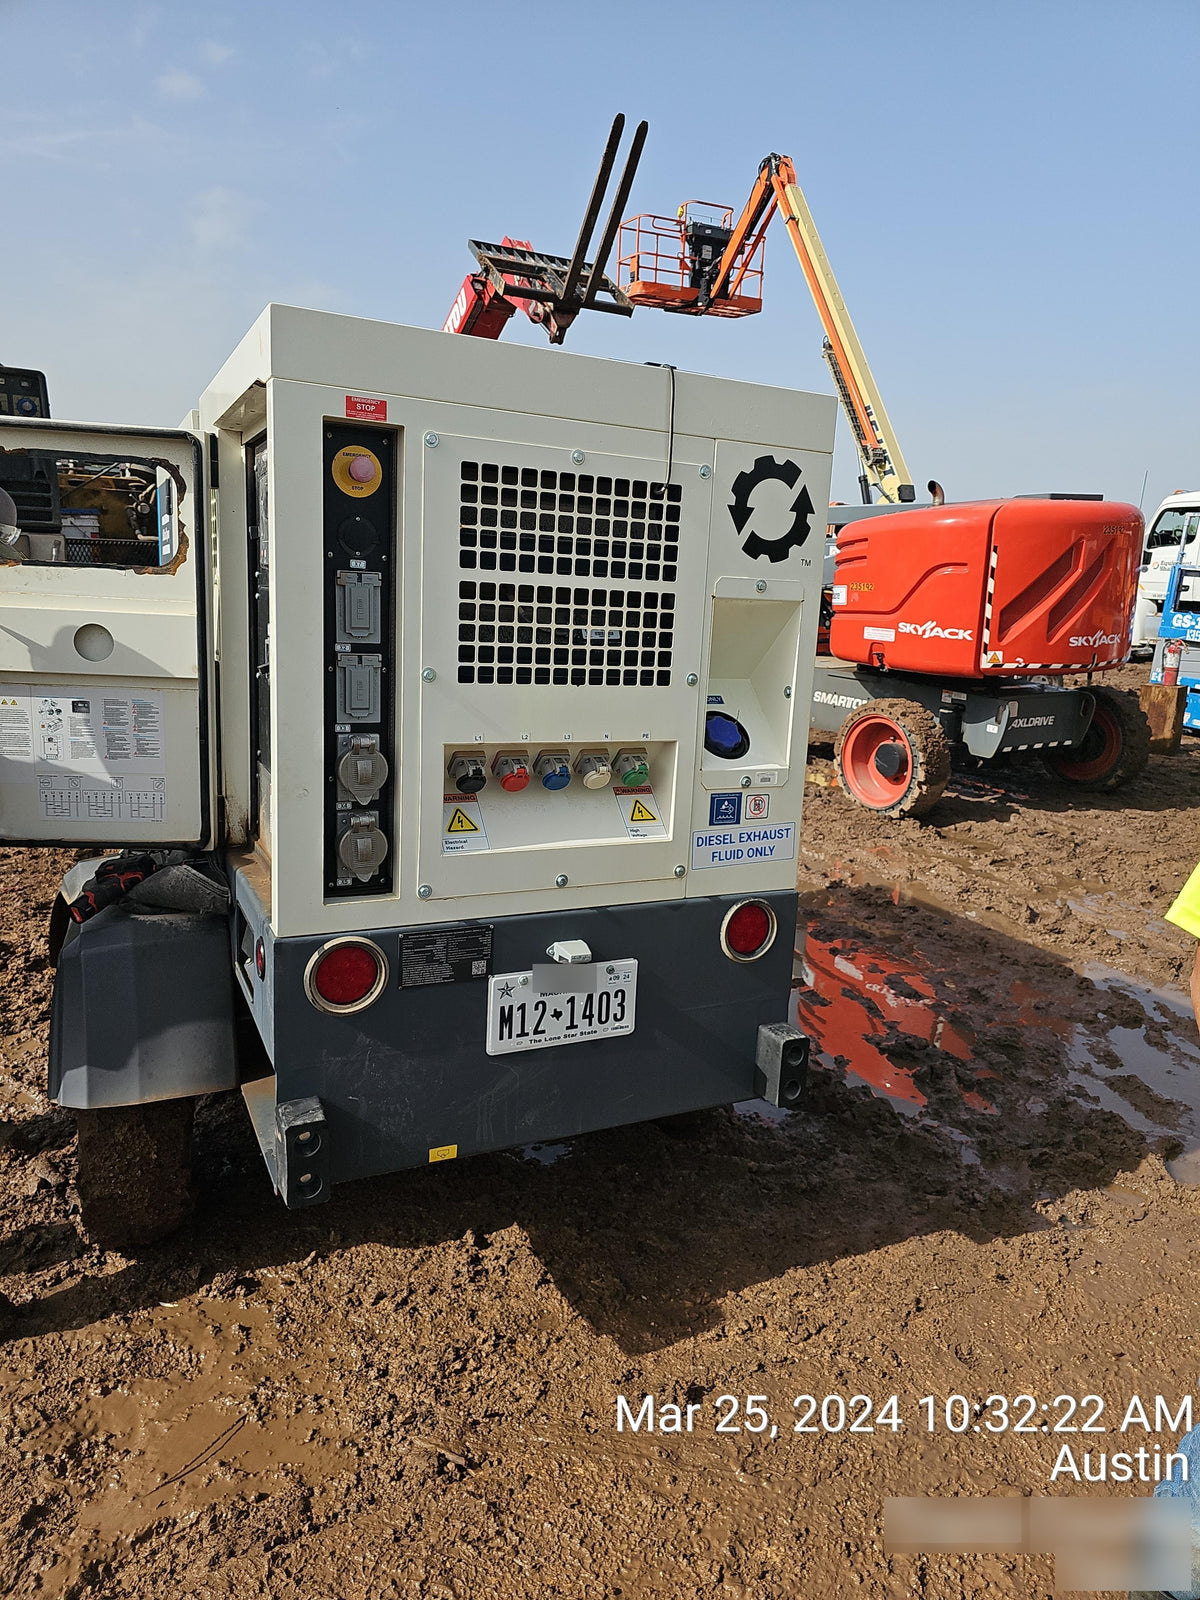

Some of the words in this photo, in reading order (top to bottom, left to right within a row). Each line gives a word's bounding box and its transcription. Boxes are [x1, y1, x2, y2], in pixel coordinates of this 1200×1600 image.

[356, 403, 376, 411] STOP
[897, 620, 974, 641] SKYJACK
[1068, 629, 1121, 648] SKYJACK
[696, 833, 735, 848] DIESEL
[738, 827, 792, 844] EXHAUST
[711, 848, 744, 862] FLUID
[747, 845, 776, 859] ONLY
[529, 1037, 541, 1045] The
[580, 1029, 598, 1037] State
